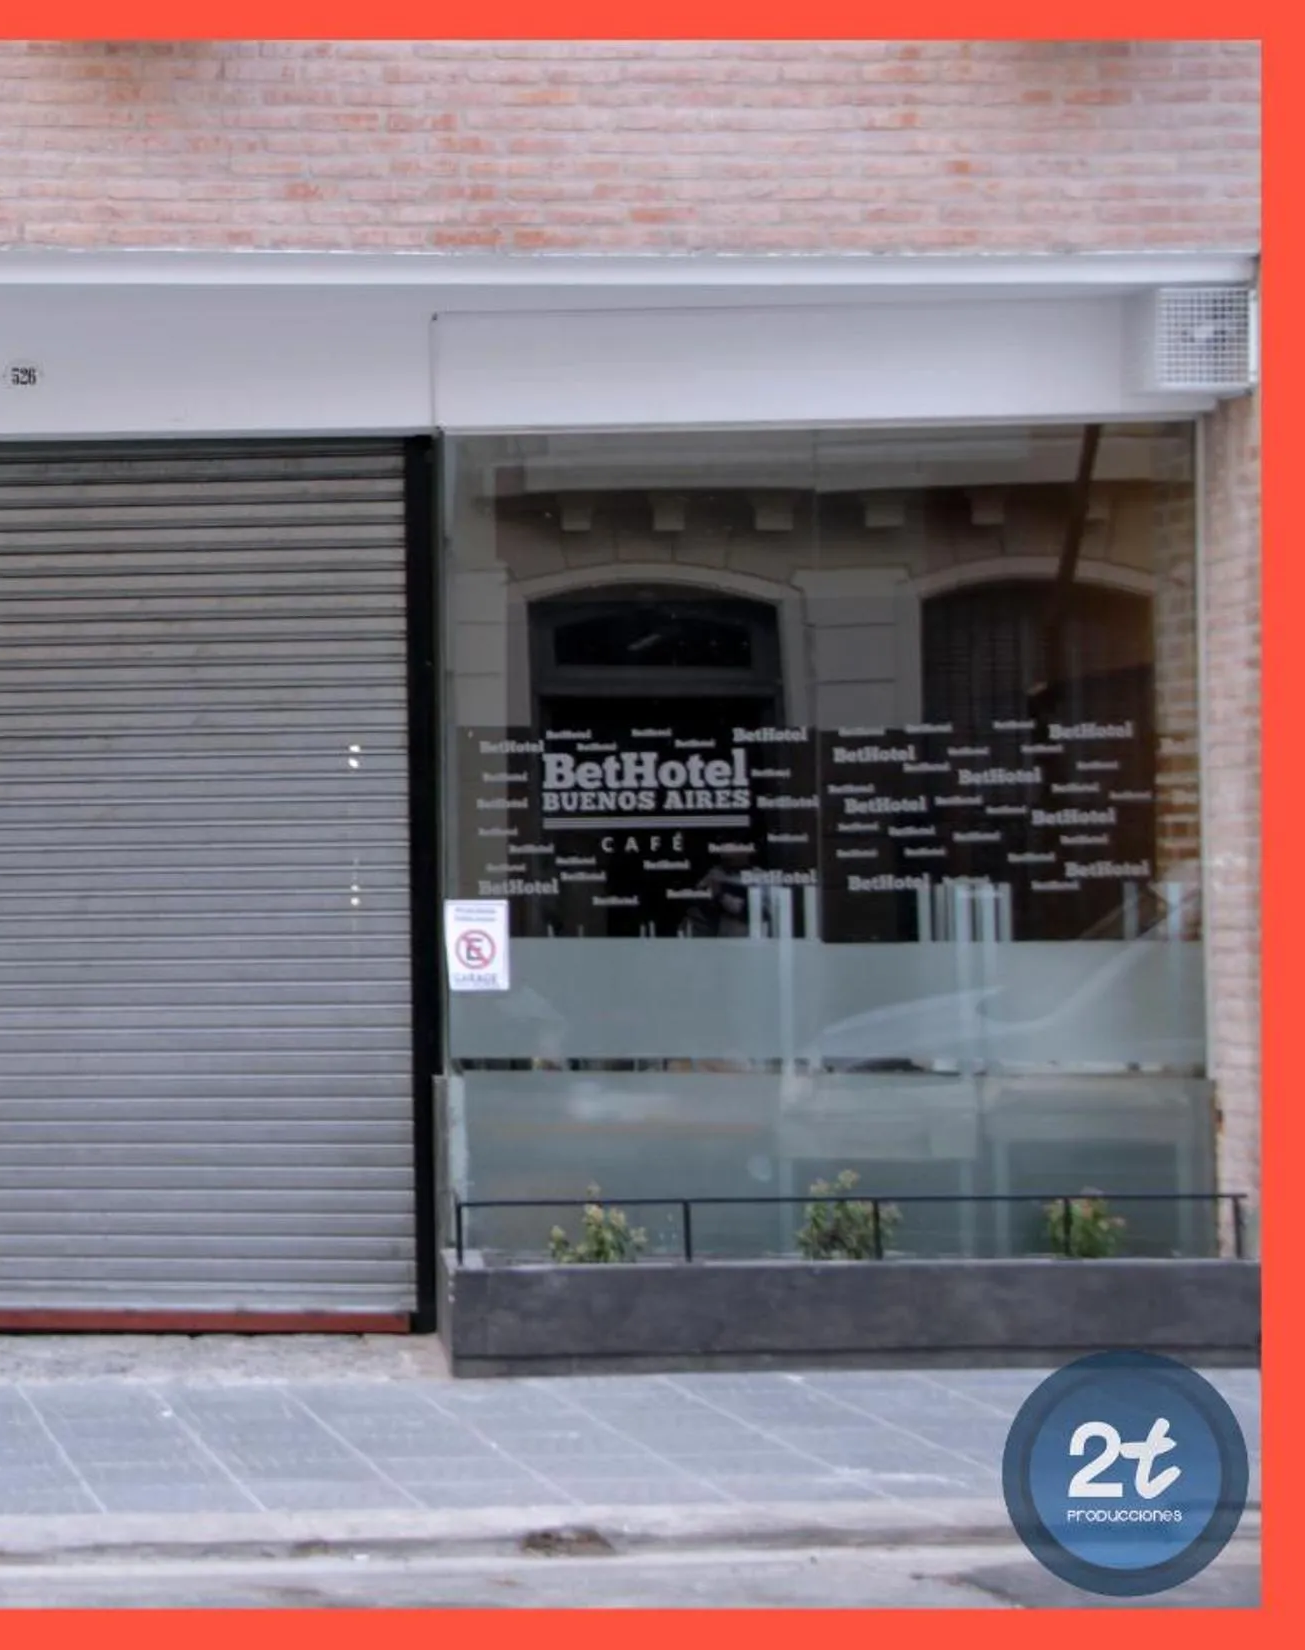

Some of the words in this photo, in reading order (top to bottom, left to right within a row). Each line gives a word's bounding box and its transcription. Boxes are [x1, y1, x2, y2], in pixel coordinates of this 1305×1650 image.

[12, 367, 37, 386] 526
[732, 727, 808, 743] BetHotel
[1049, 721, 1133, 740] BetHotel
[480, 740, 544, 753] BetHotel
[833, 745, 916, 763] BetHotel
[543, 748, 749, 790] BetHotel
[959, 766, 1042, 785] BetHotel
[542, 790, 656, 812] BUENOS
[663, 789, 750, 810] AIRES
[844, 795, 927, 814] BetHotel
[1032, 807, 1116, 826] BetHotel
[600, 832, 684, 853] CAFÉ
[740, 869, 818, 885] BetHotel
[1065, 860, 1150, 878] BetHotel
[479, 878, 559, 895] BetHotel
